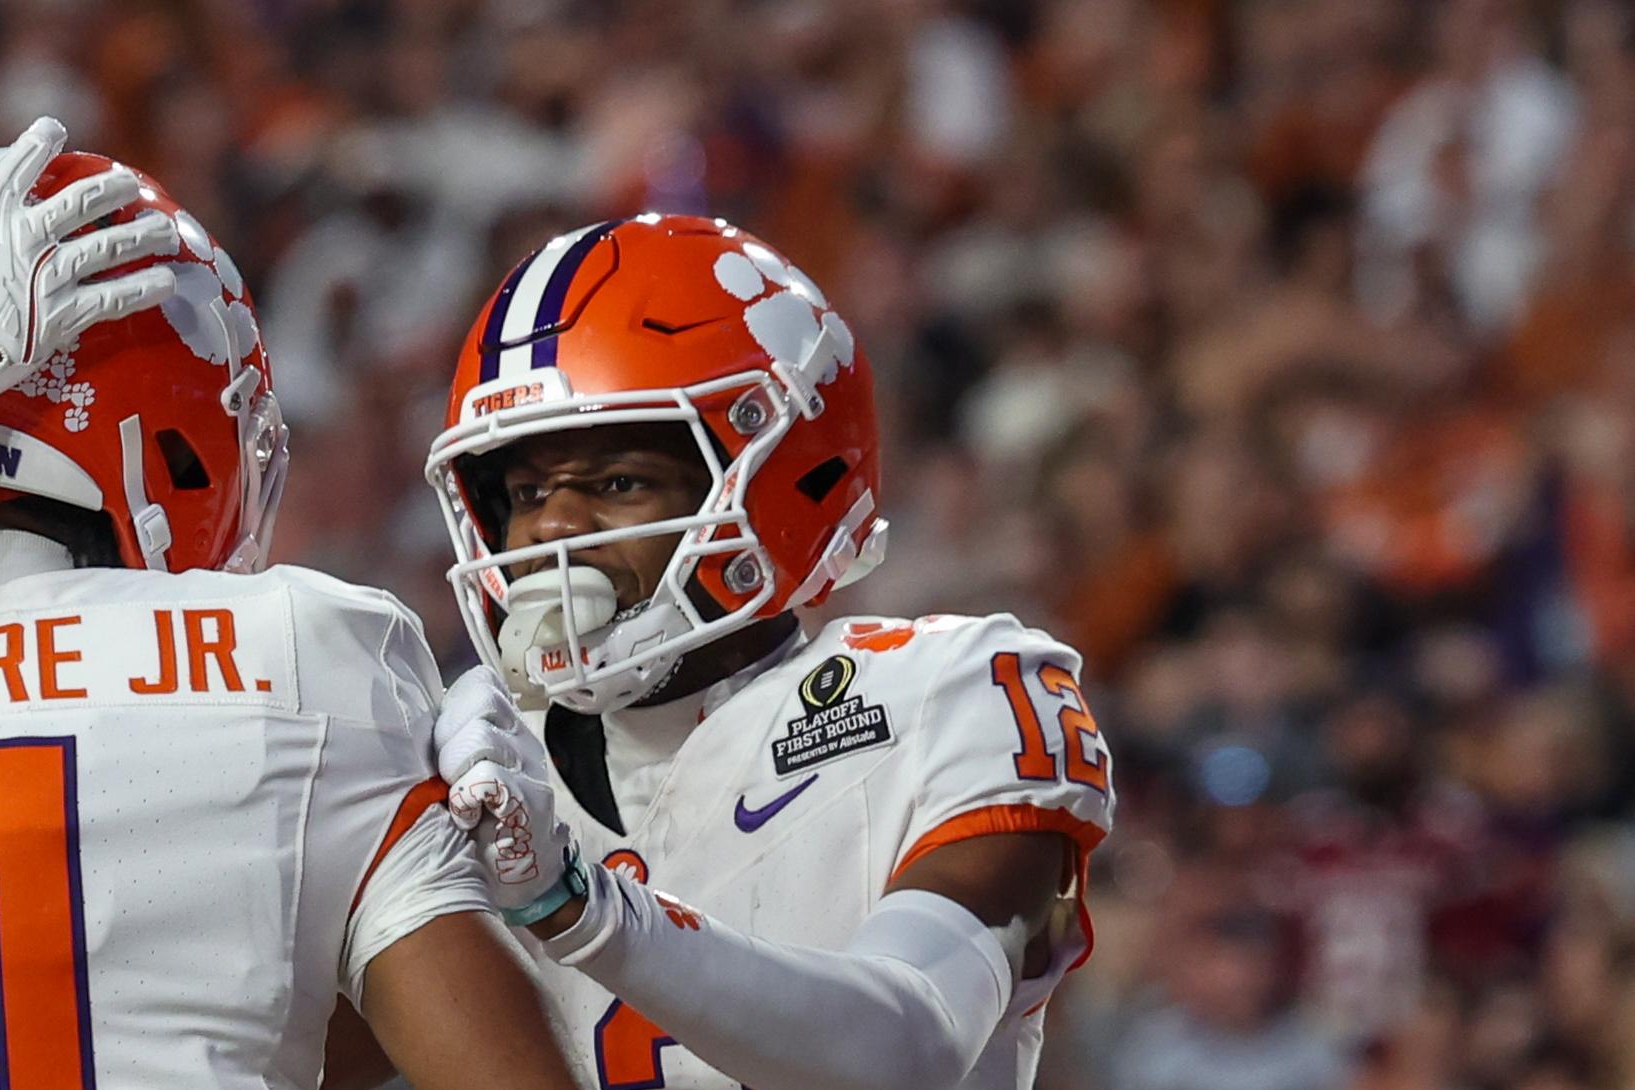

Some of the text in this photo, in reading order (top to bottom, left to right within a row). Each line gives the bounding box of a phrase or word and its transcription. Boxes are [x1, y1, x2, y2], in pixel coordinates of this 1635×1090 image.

[472, 382, 544, 418] TIGERS
[128, 608, 272, 696] JR.
[776, 709, 881, 757] FIRST ROUND
[791, 698, 860, 736] PLAYOFF
[990, 652, 1109, 794] 12
[787, 730, 876, 766] PRESENTED BY Allstate
